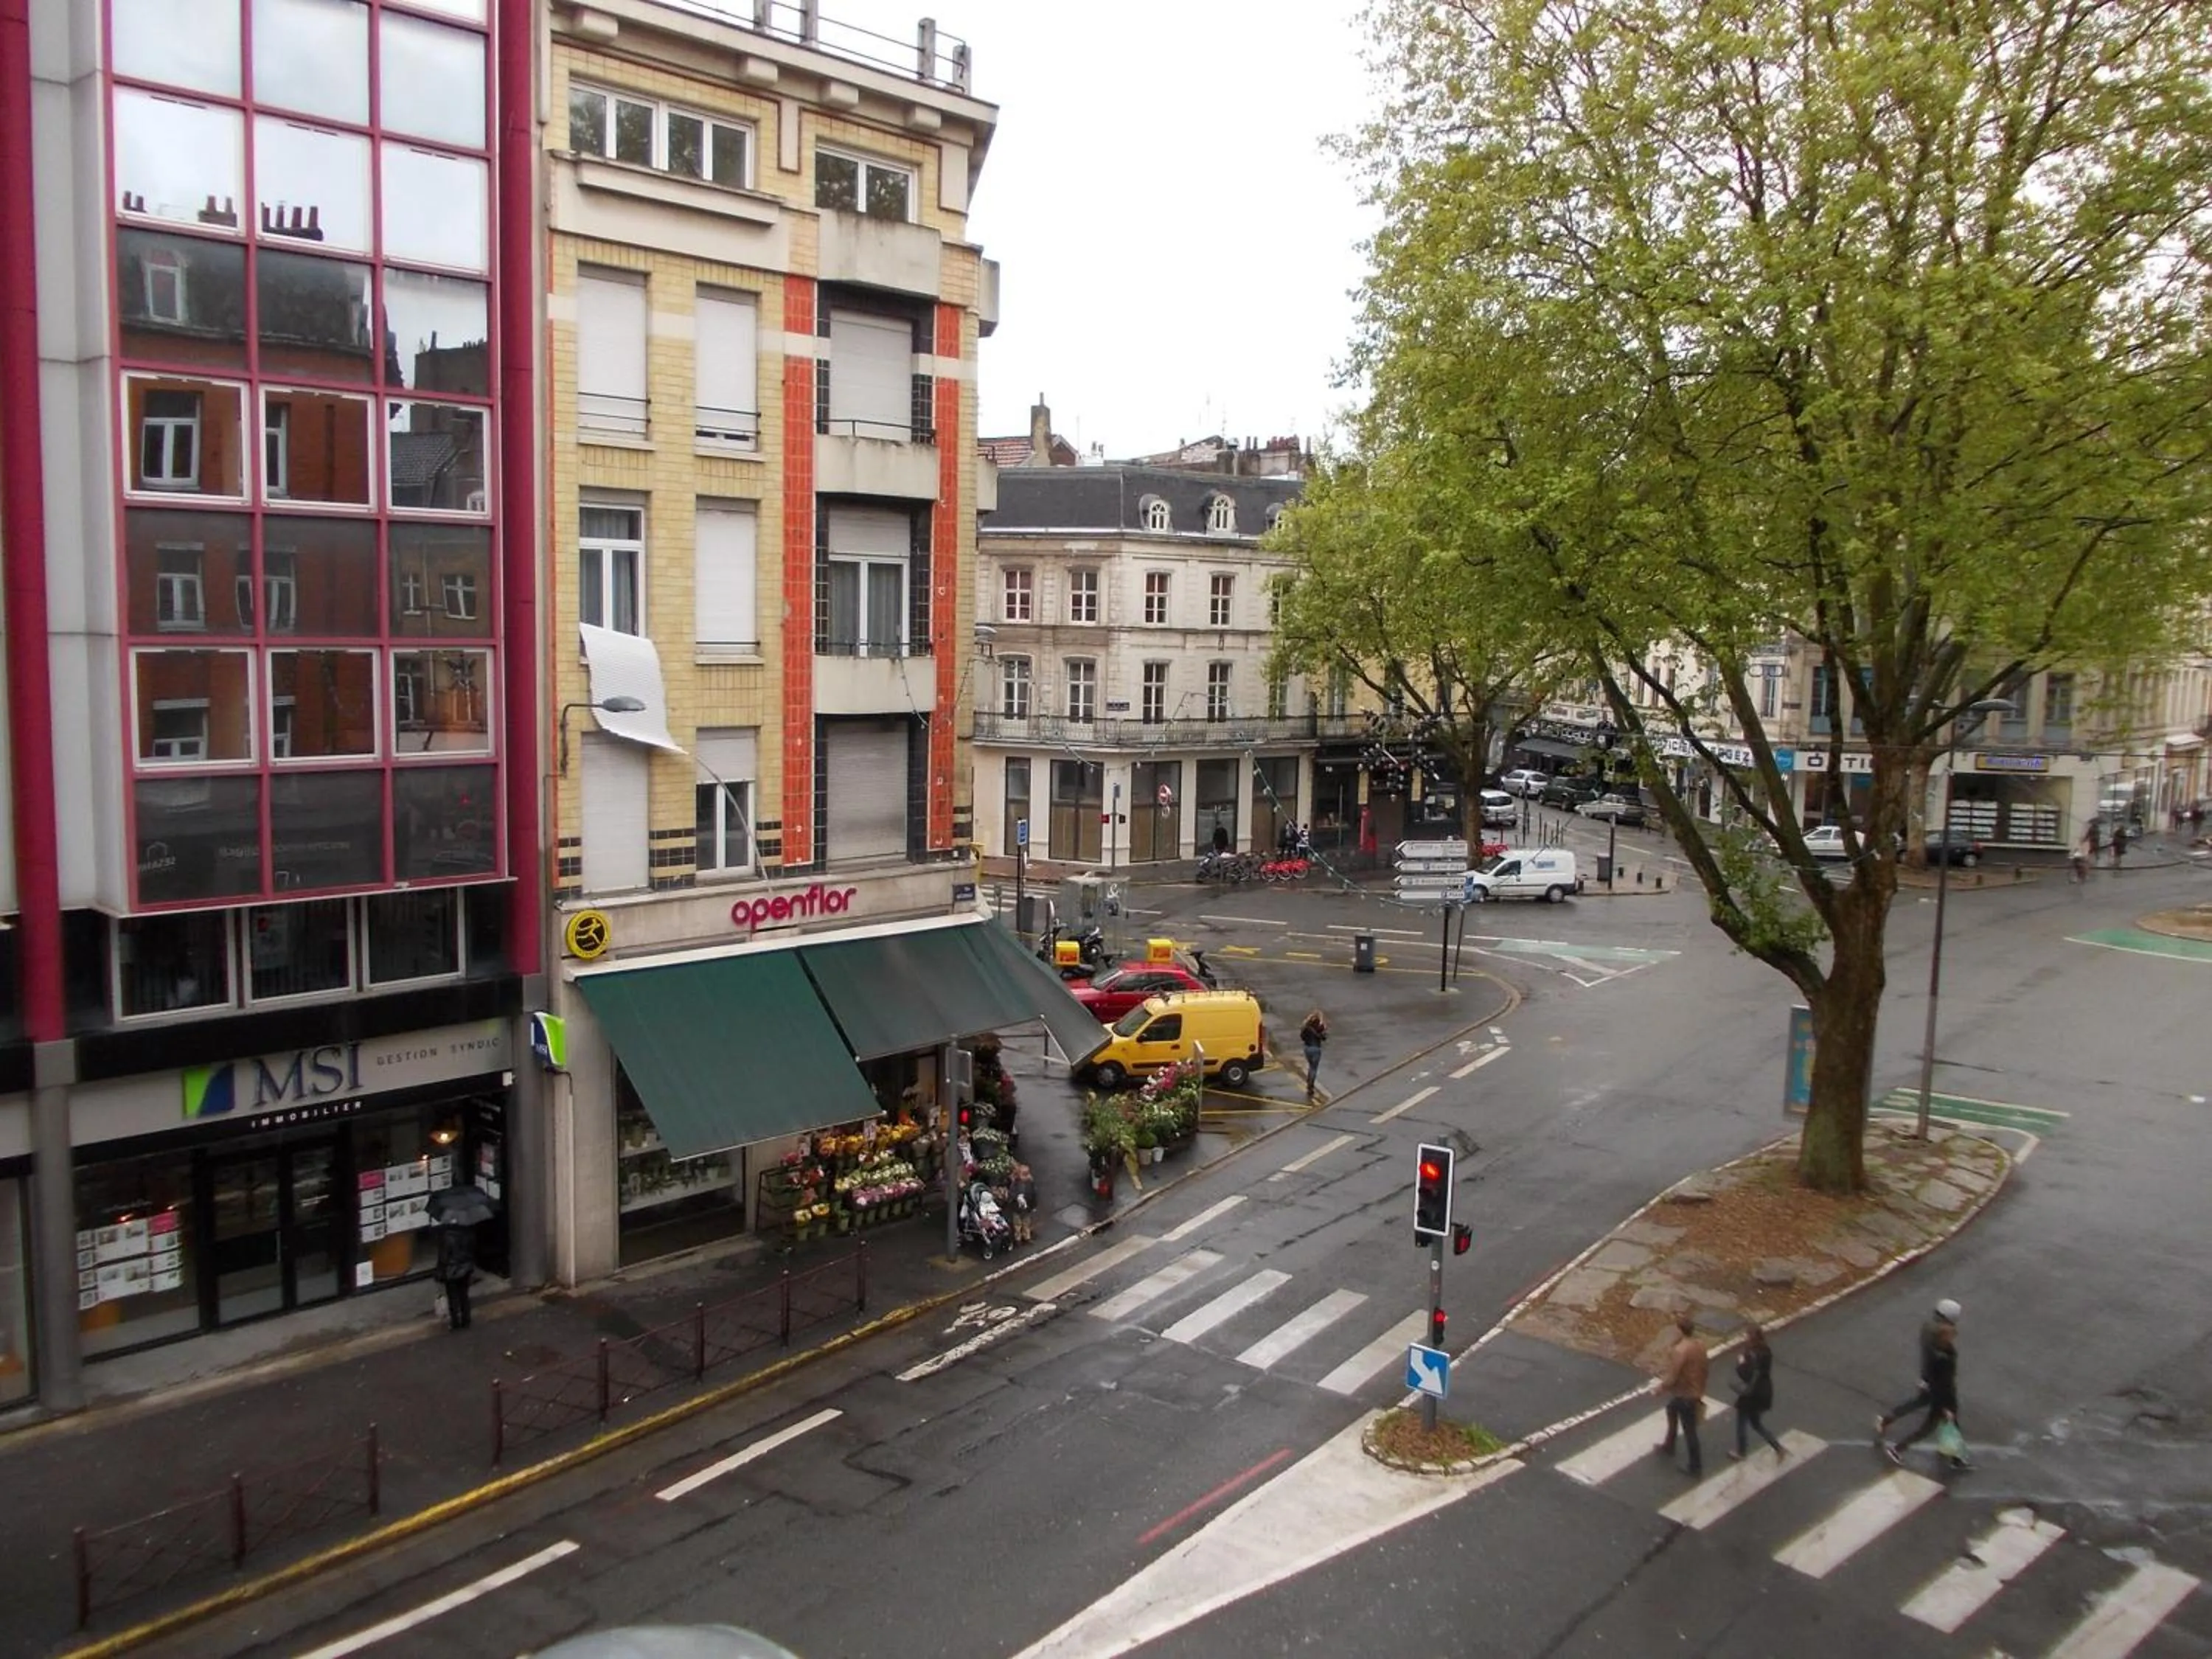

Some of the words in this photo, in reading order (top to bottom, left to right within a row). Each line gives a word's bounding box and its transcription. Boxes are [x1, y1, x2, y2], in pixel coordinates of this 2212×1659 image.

[731, 883, 857, 933] openflor
[376, 1048, 437, 1066] GESTION
[450, 1037, 501, 1054] SYNDIC
[251, 1040, 364, 1107] MSI
[251, 1101, 362, 1129] IMMOBILIER
